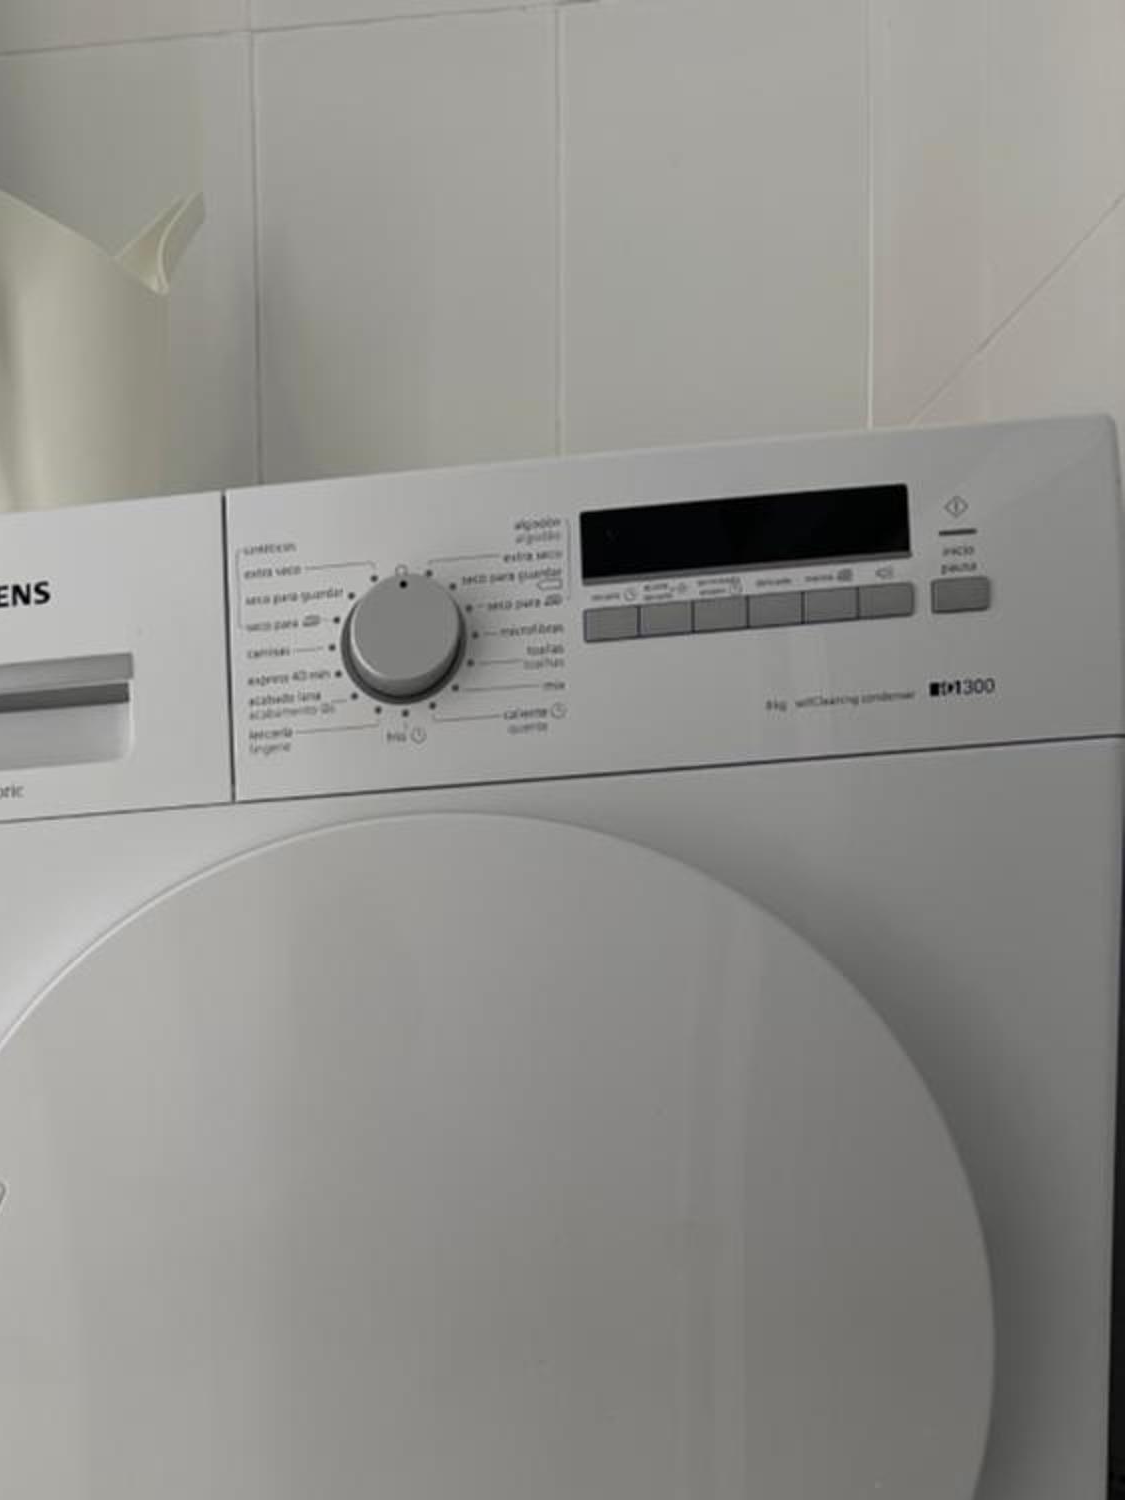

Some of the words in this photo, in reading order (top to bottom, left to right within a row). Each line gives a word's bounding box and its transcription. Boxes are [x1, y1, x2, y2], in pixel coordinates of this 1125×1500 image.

[275, 565, 301, 576] seco
[246, 595, 270, 605] seco
[273, 592, 298, 606] para
